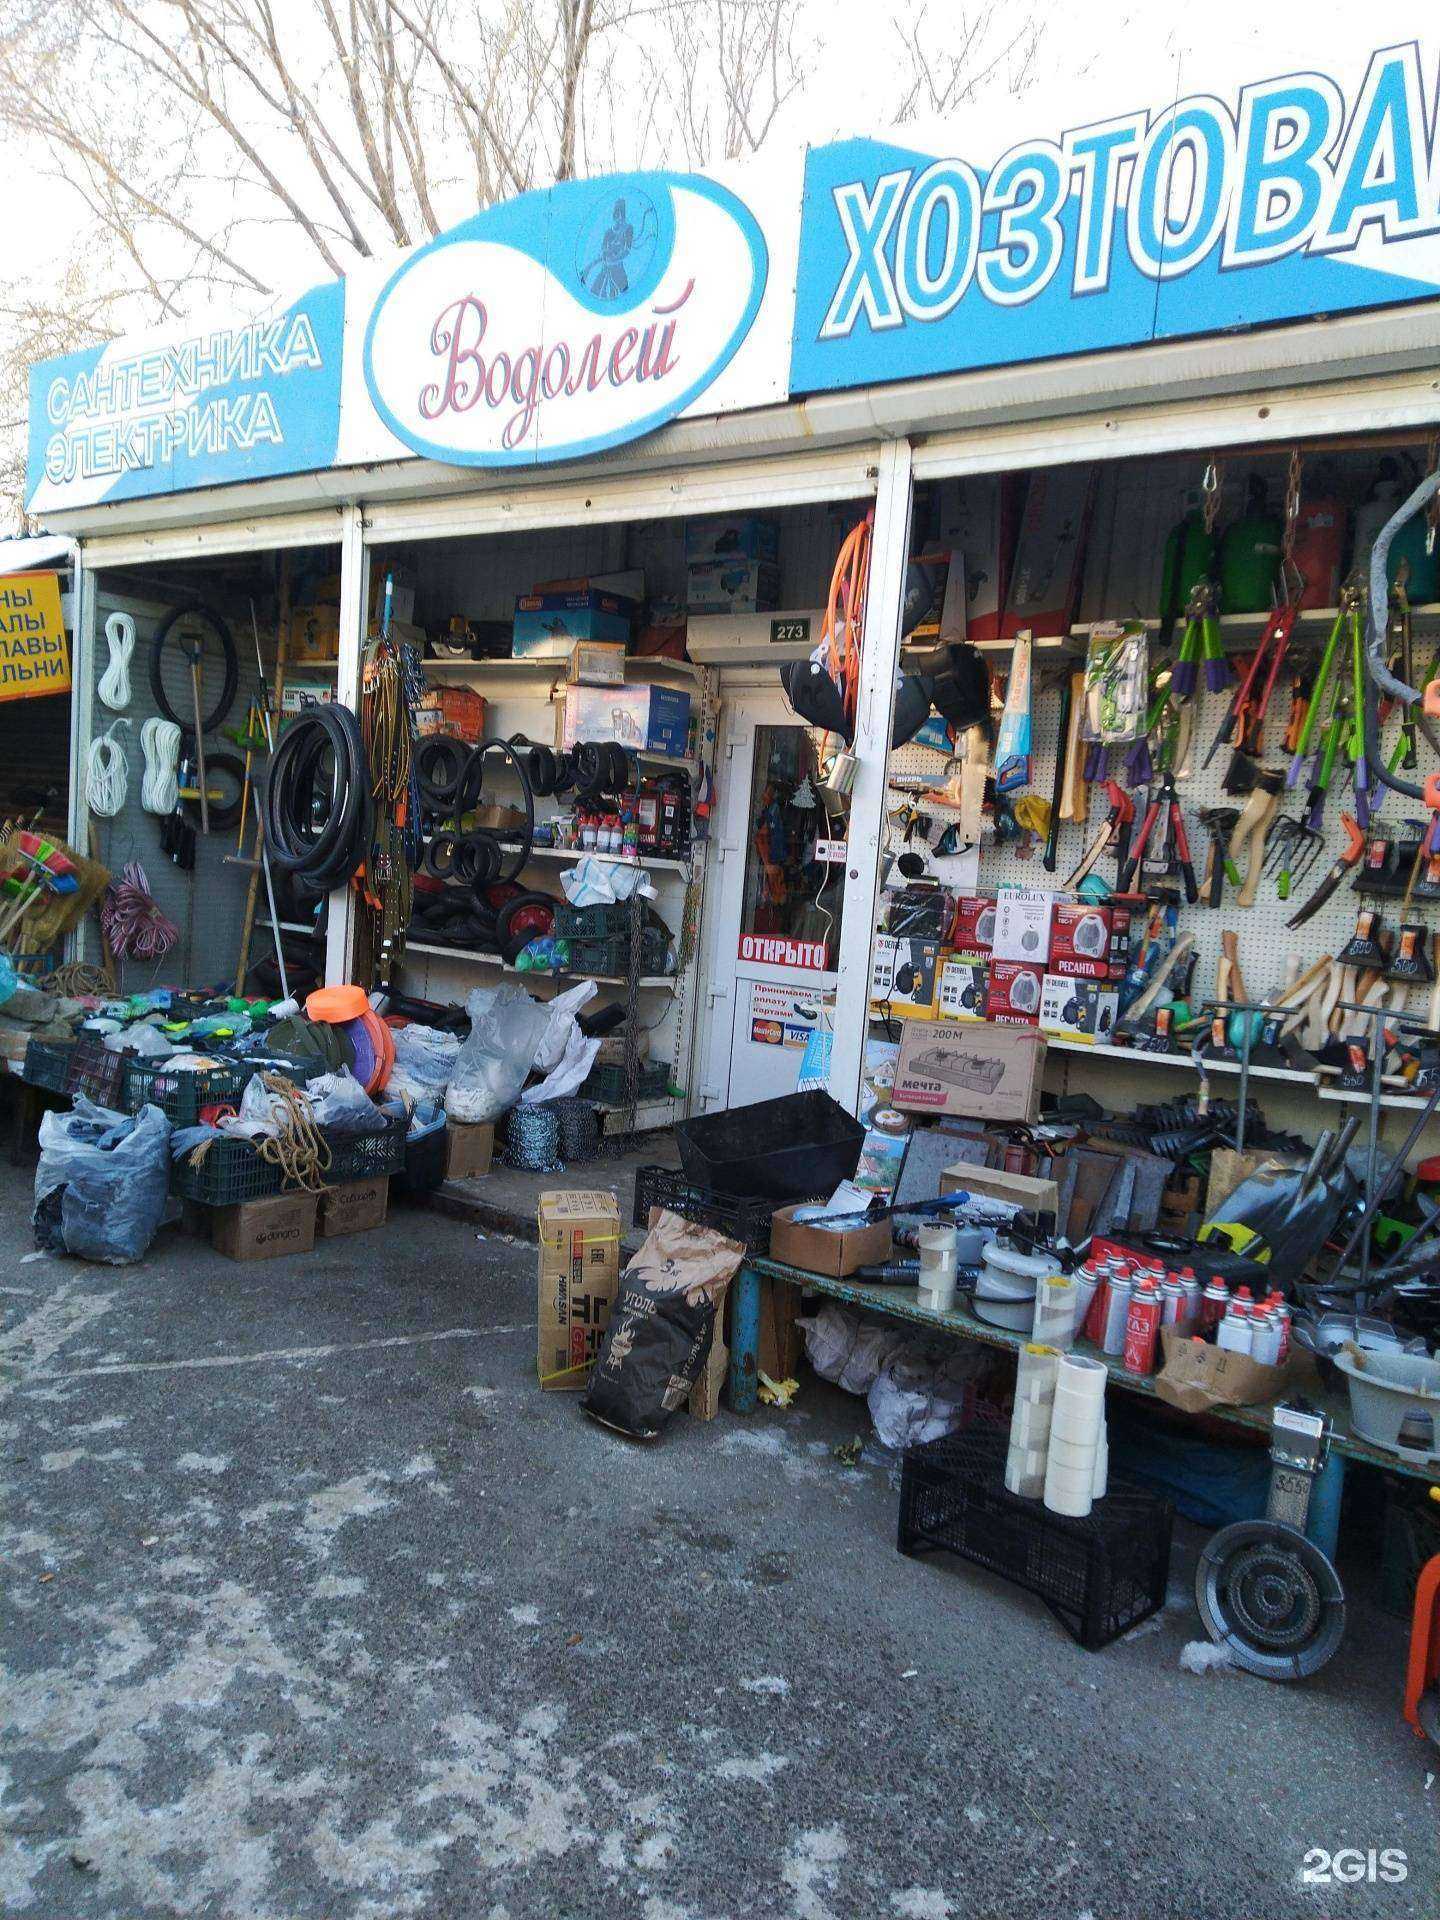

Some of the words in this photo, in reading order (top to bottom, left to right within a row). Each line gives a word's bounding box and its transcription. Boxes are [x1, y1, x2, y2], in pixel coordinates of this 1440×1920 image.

[816, 38, 1440, 341] ХОЗТОВА
[46, 313, 323, 425] САНТЕХНИКА
[418, 278, 696, 449] Водолей
[45, 391, 283, 485] ЭЛЕКТРИКА
[777, 625, 804, 640] 273
[1004, 891, 1046, 902] EUROLUX
[741, 936, 825, 968] ОТКРЫТО
[1058, 960, 1096, 975] РЕСАНТА
[754, 984, 812, 999] Принимаем
[754, 996, 787, 1007] оплату
[753, 1007, 794, 1019] картами
[790, 1030, 810, 1041] VISA
[902, 1079, 942, 1092] мечта
[623, 1290, 658, 1315] УГОЛЬ
